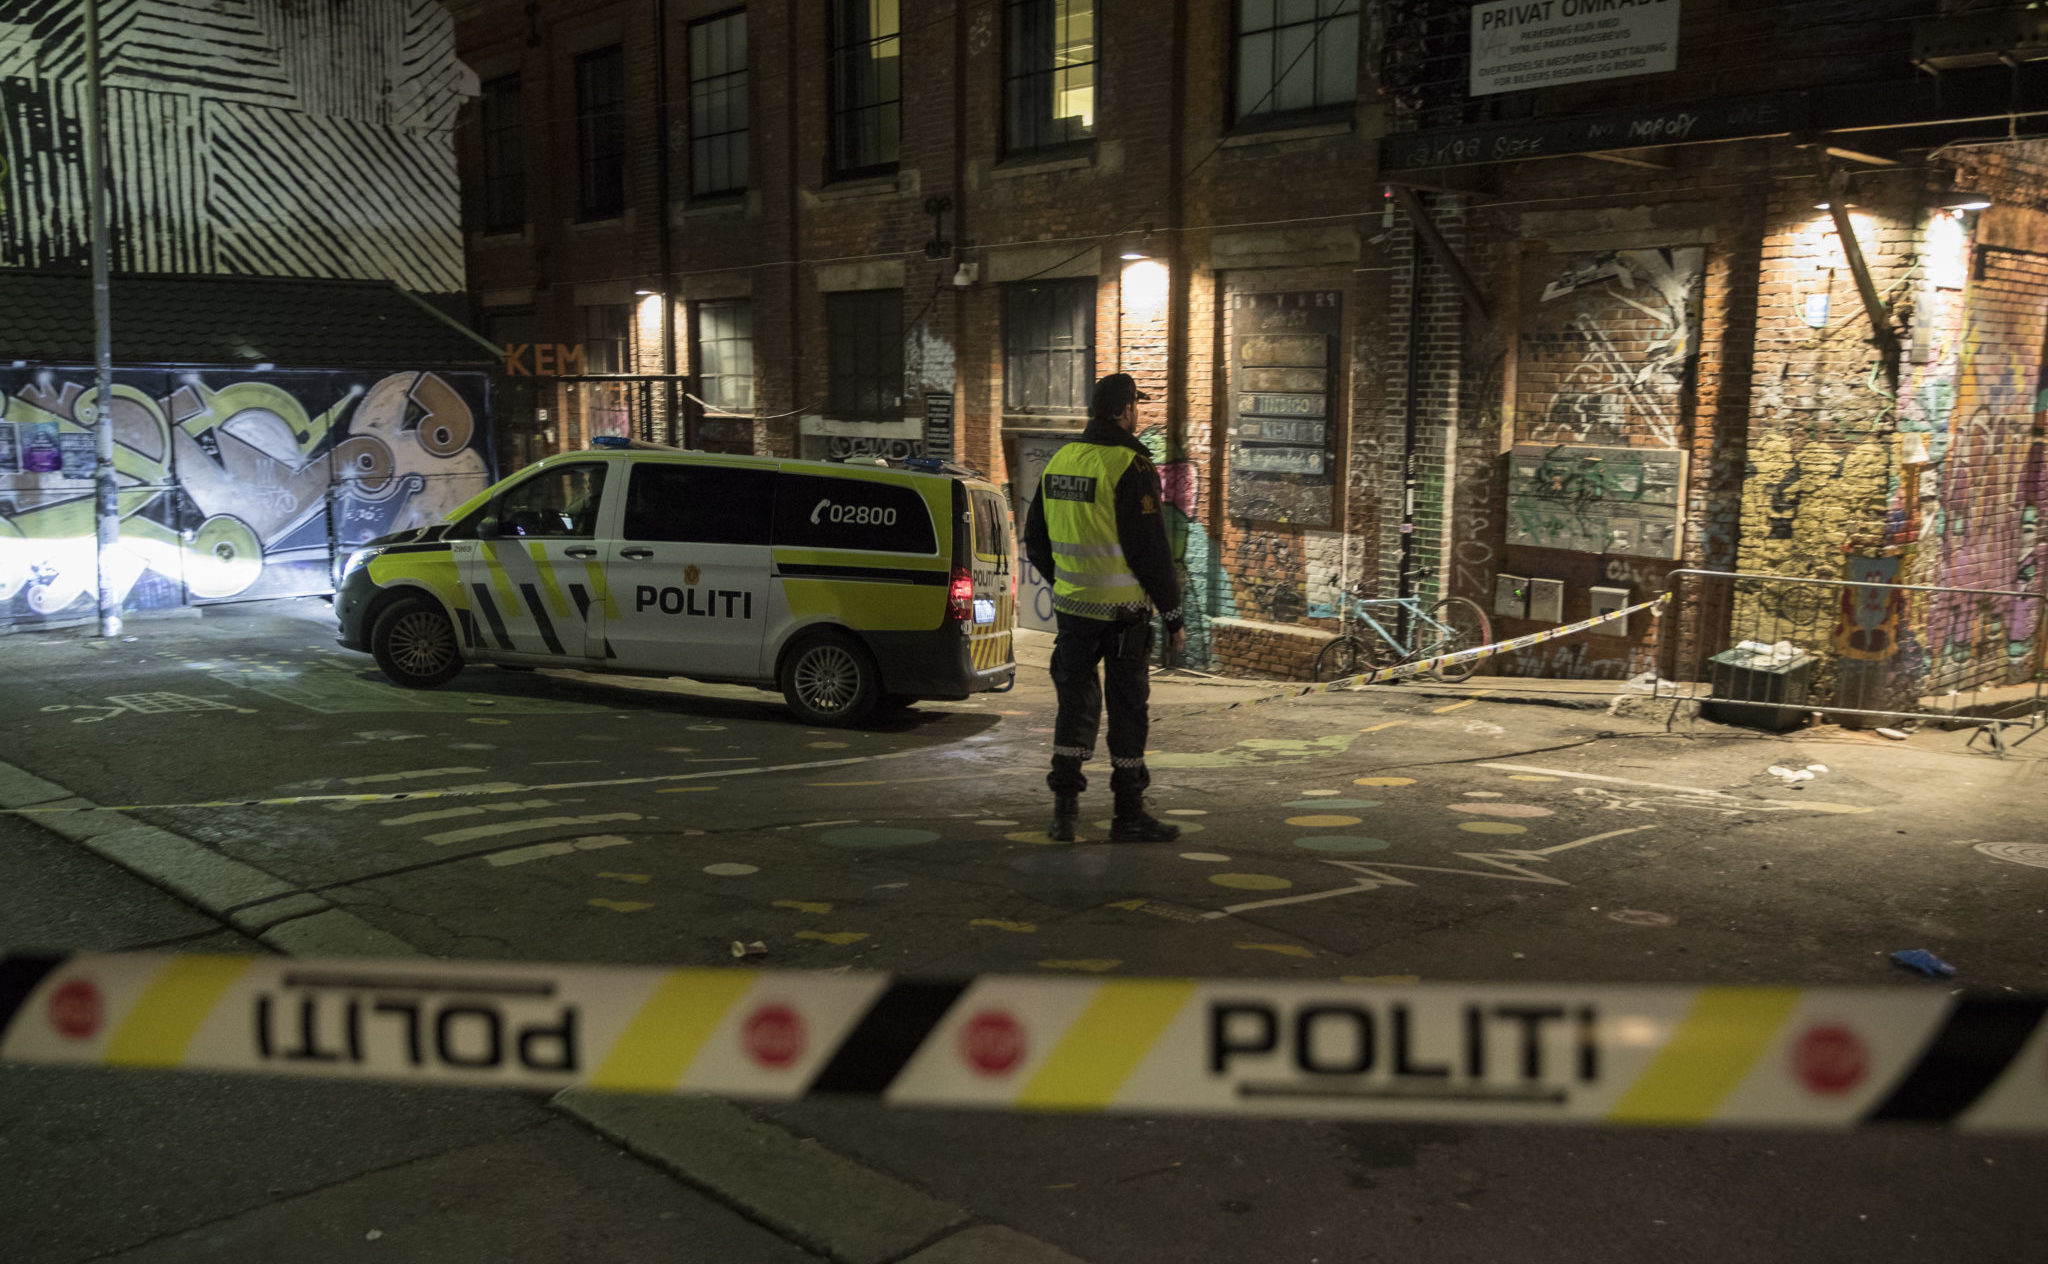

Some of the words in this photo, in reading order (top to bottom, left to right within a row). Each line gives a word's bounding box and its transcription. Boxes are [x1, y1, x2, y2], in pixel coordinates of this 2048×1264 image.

[1482, 1, 1553, 31] PRIVAT
[1521, 24, 1572, 40] PARKERING
[1575, 21, 1594, 33] KUN
[1597, 17, 1620, 30] MED
[1510, 42, 1541, 55] SYNLIG
[1544, 29, 1631, 50] PARKERINGSBEVIS
[1478, 59, 1544, 77] OVERTREDELSE
[1546, 52, 1598, 67] MEDFØRER
[1601, 43, 1667, 60] BORTTAUING
[1494, 77, 1511, 87] FOR
[1514, 71, 1550, 84] BILEIERS
[1552, 65, 1594, 78] REGNING
[1597, 62, 1612, 73] OG
[1614, 58, 1647, 71] RISIKO
[506, 343, 584, 376] KEM
[1051, 475, 1089, 492] POLITI
[828, 503, 897, 527] 02800
[636, 585, 752, 619] POLITI
[257, 998, 578, 1071] POLITI
[1208, 1003, 1598, 1079] POLITI
